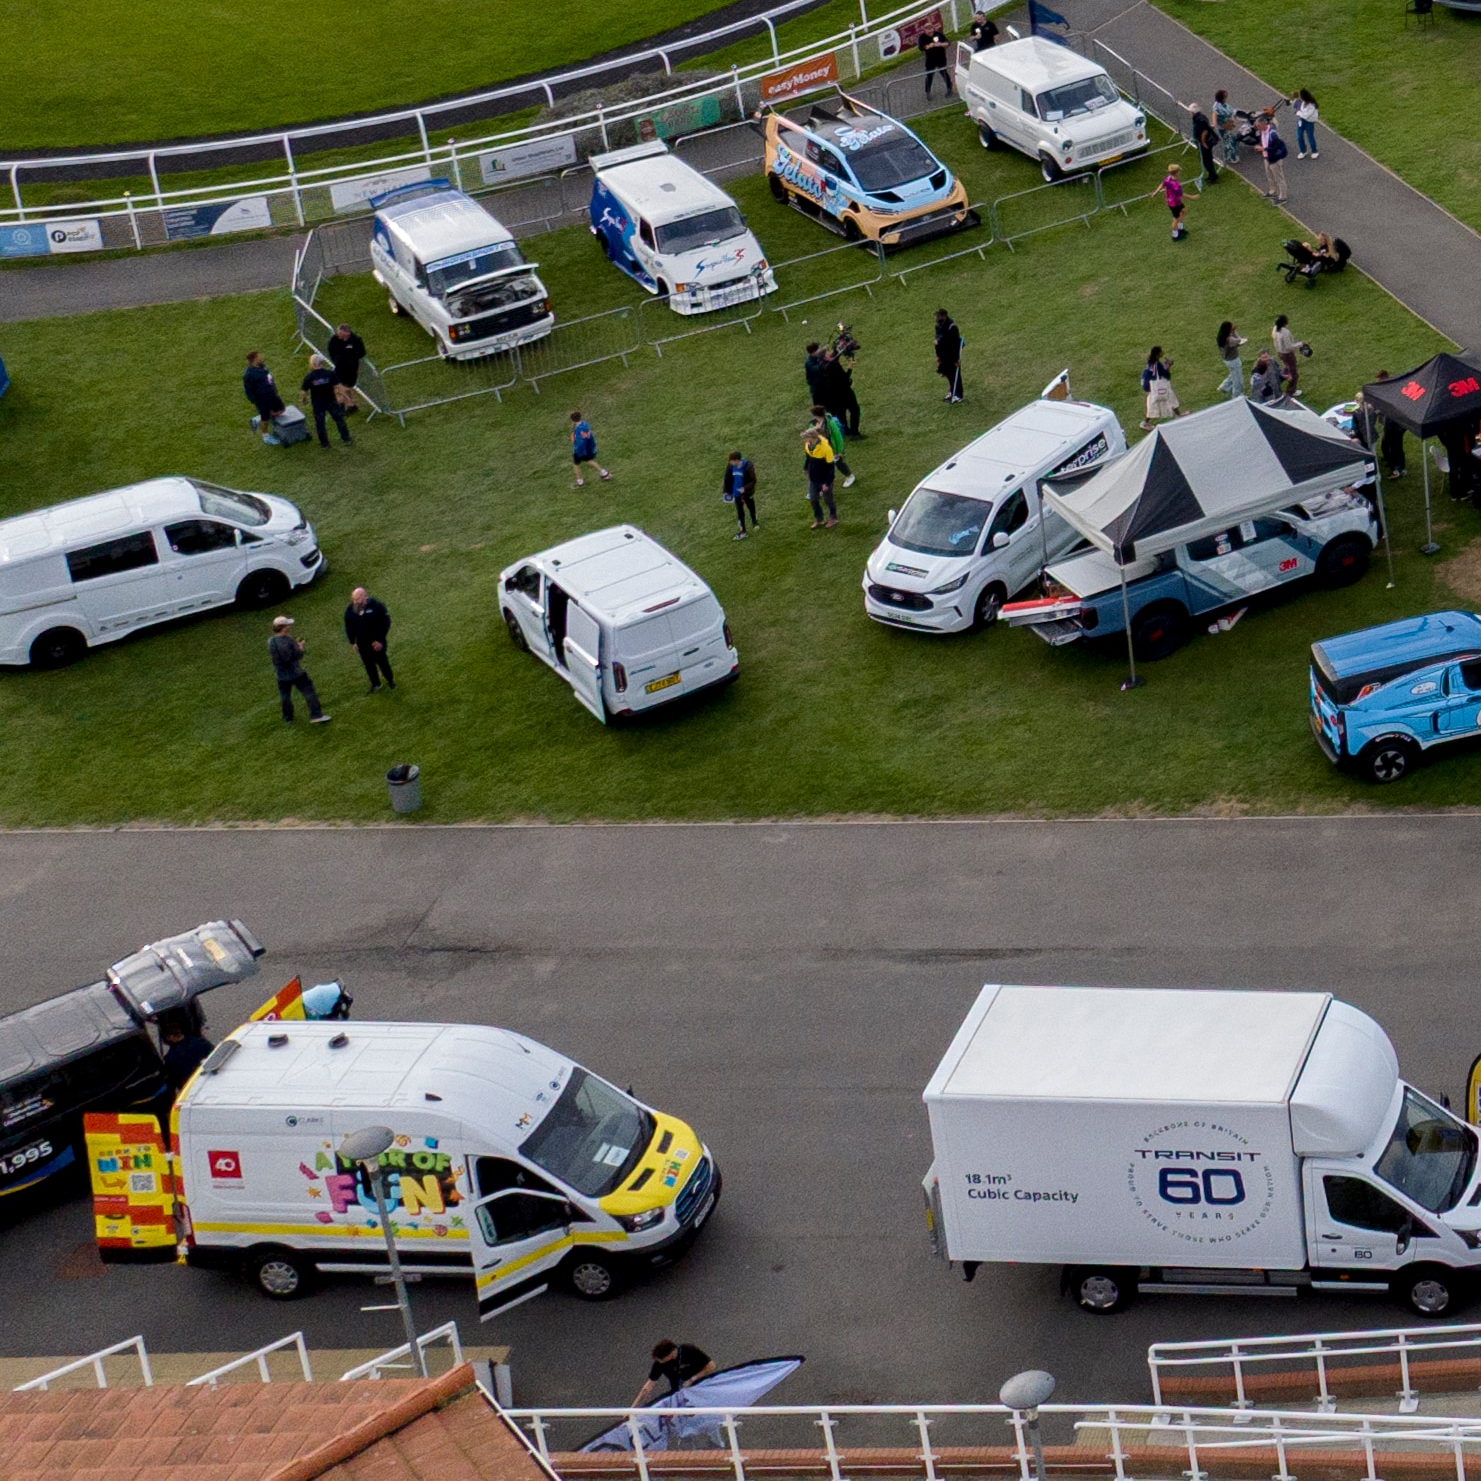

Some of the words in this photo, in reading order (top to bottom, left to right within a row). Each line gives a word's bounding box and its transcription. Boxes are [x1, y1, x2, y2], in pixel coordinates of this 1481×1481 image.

[767, 64, 832, 95] easyMoney
[772, 143, 823, 199] Gelato
[1400, 381, 1426, 401] 3M
[1448, 377, 1481, 397] 3M
[1278, 557, 1298, 571] 3M
[97, 1155, 152, 1173] WIN
[314, 1151, 334, 1173] A
[412, 1150, 452, 1173] OF
[1134, 1149, 1262, 1162] TRANSIT
[326, 1171, 447, 1215] FUN
[968, 1189, 1010, 1200] Cubic
[1014, 1189, 1080, 1203] Capacity
[1158, 1167, 1246, 1205] 60
[1176, 1211, 1234, 1220] YEARS
